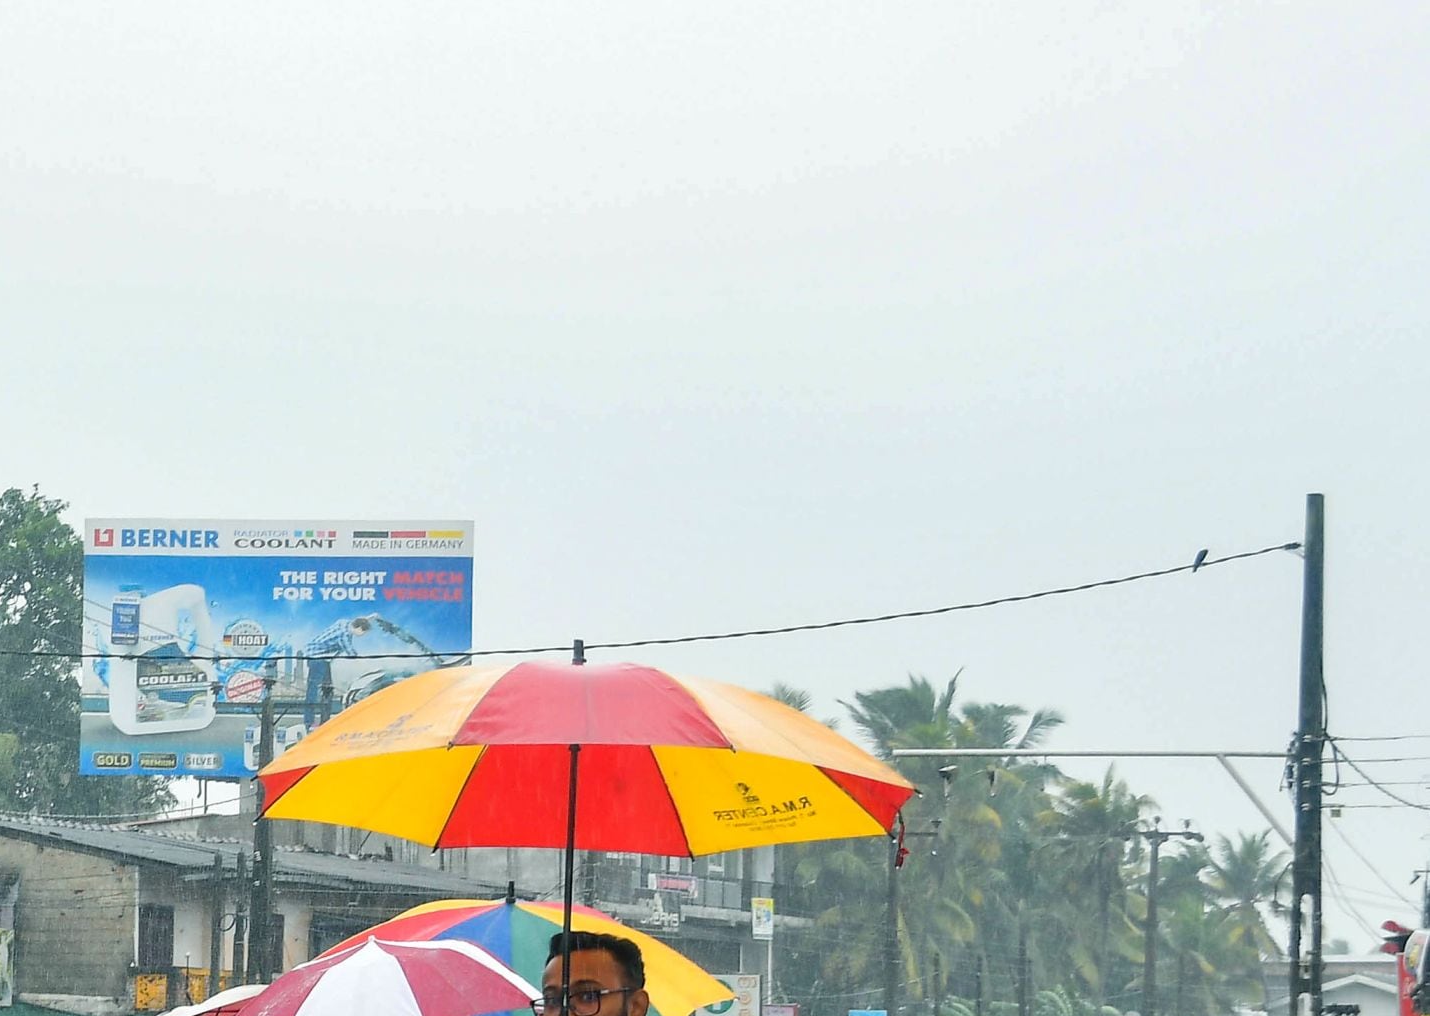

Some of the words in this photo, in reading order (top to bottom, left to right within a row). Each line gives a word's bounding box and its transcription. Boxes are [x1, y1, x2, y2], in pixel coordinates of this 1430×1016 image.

[121, 529, 219, 548] BERNER
[234, 538, 337, 549] COOLANT
[352, 540, 386, 549] MADE
[390, 541, 402, 549] IN
[406, 540, 464, 550] GERMANY
[280, 571, 317, 584] THE
[324, 571, 387, 584] RIGHT
[393, 571, 464, 584] MATCH
[273, 587, 313, 601] FOR
[320, 587, 376, 601] YOUR
[383, 588, 464, 602] VEHICLE
[238, 635, 267, 646] HOAT
[97, 756, 129, 766] GOLD
[140, 758, 175, 767] PREMIUM
